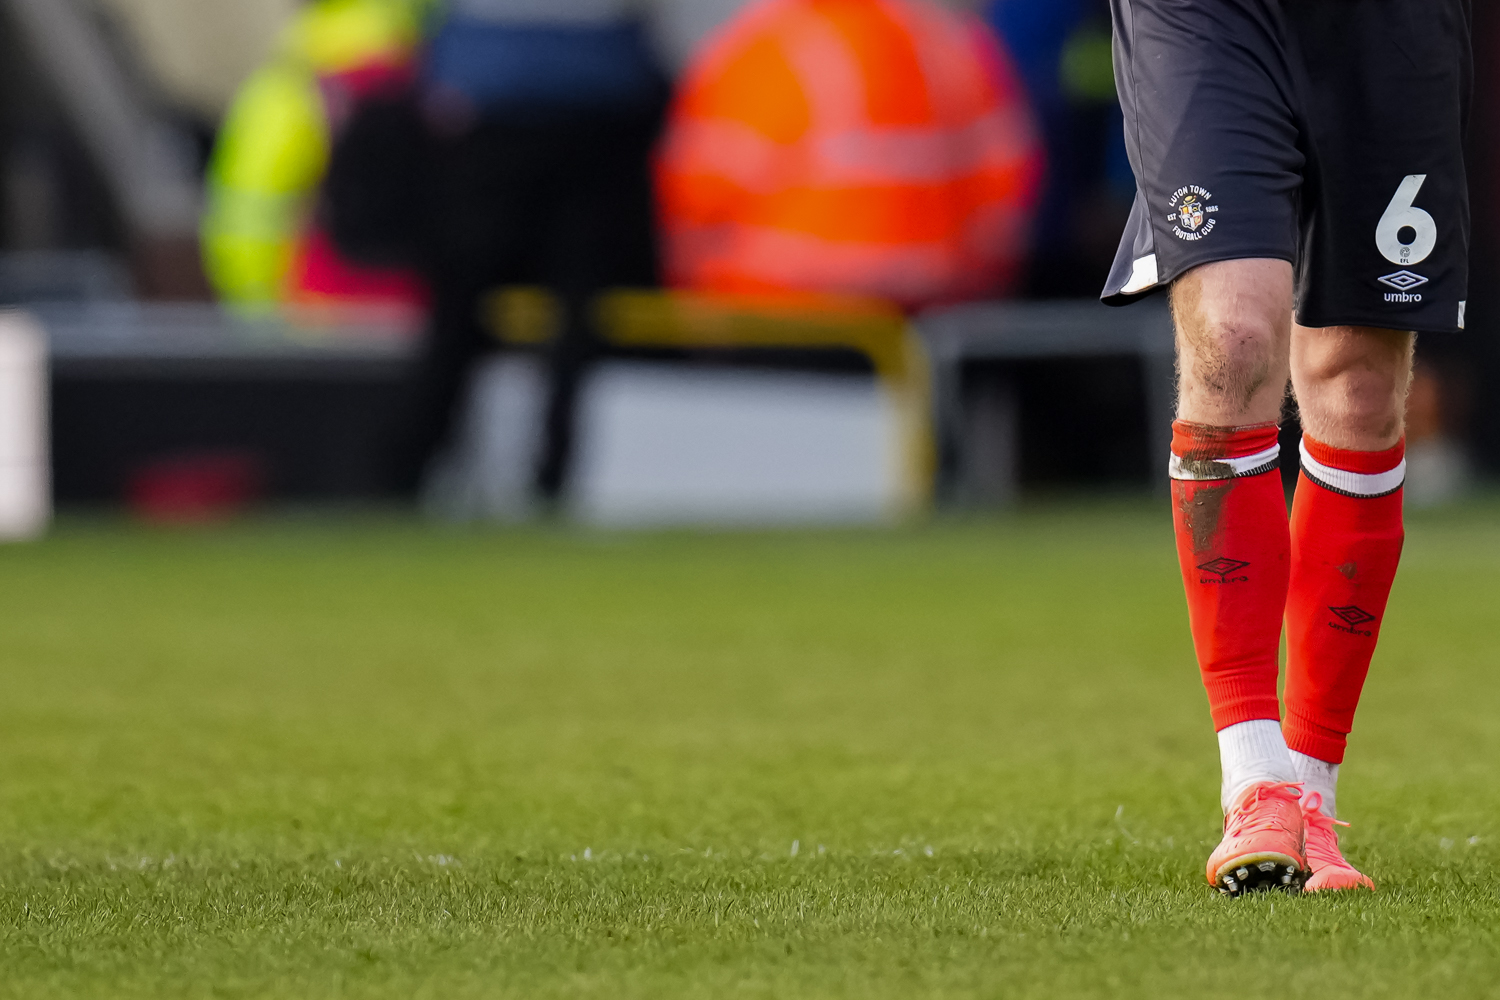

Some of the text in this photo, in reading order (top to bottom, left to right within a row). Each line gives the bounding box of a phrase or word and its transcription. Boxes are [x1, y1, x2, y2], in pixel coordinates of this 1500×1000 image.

[1169, 185, 1212, 207] LUTON TOWN
[1167, 213, 1177, 221] EST
[1375, 174, 1437, 265] 6
[1172, 218, 1216, 240] FOOTBALL CLUB
[1383, 292, 1422, 303] umbro
[1200, 575, 1249, 584] umbro
[1328, 621, 1372, 637] umbro
